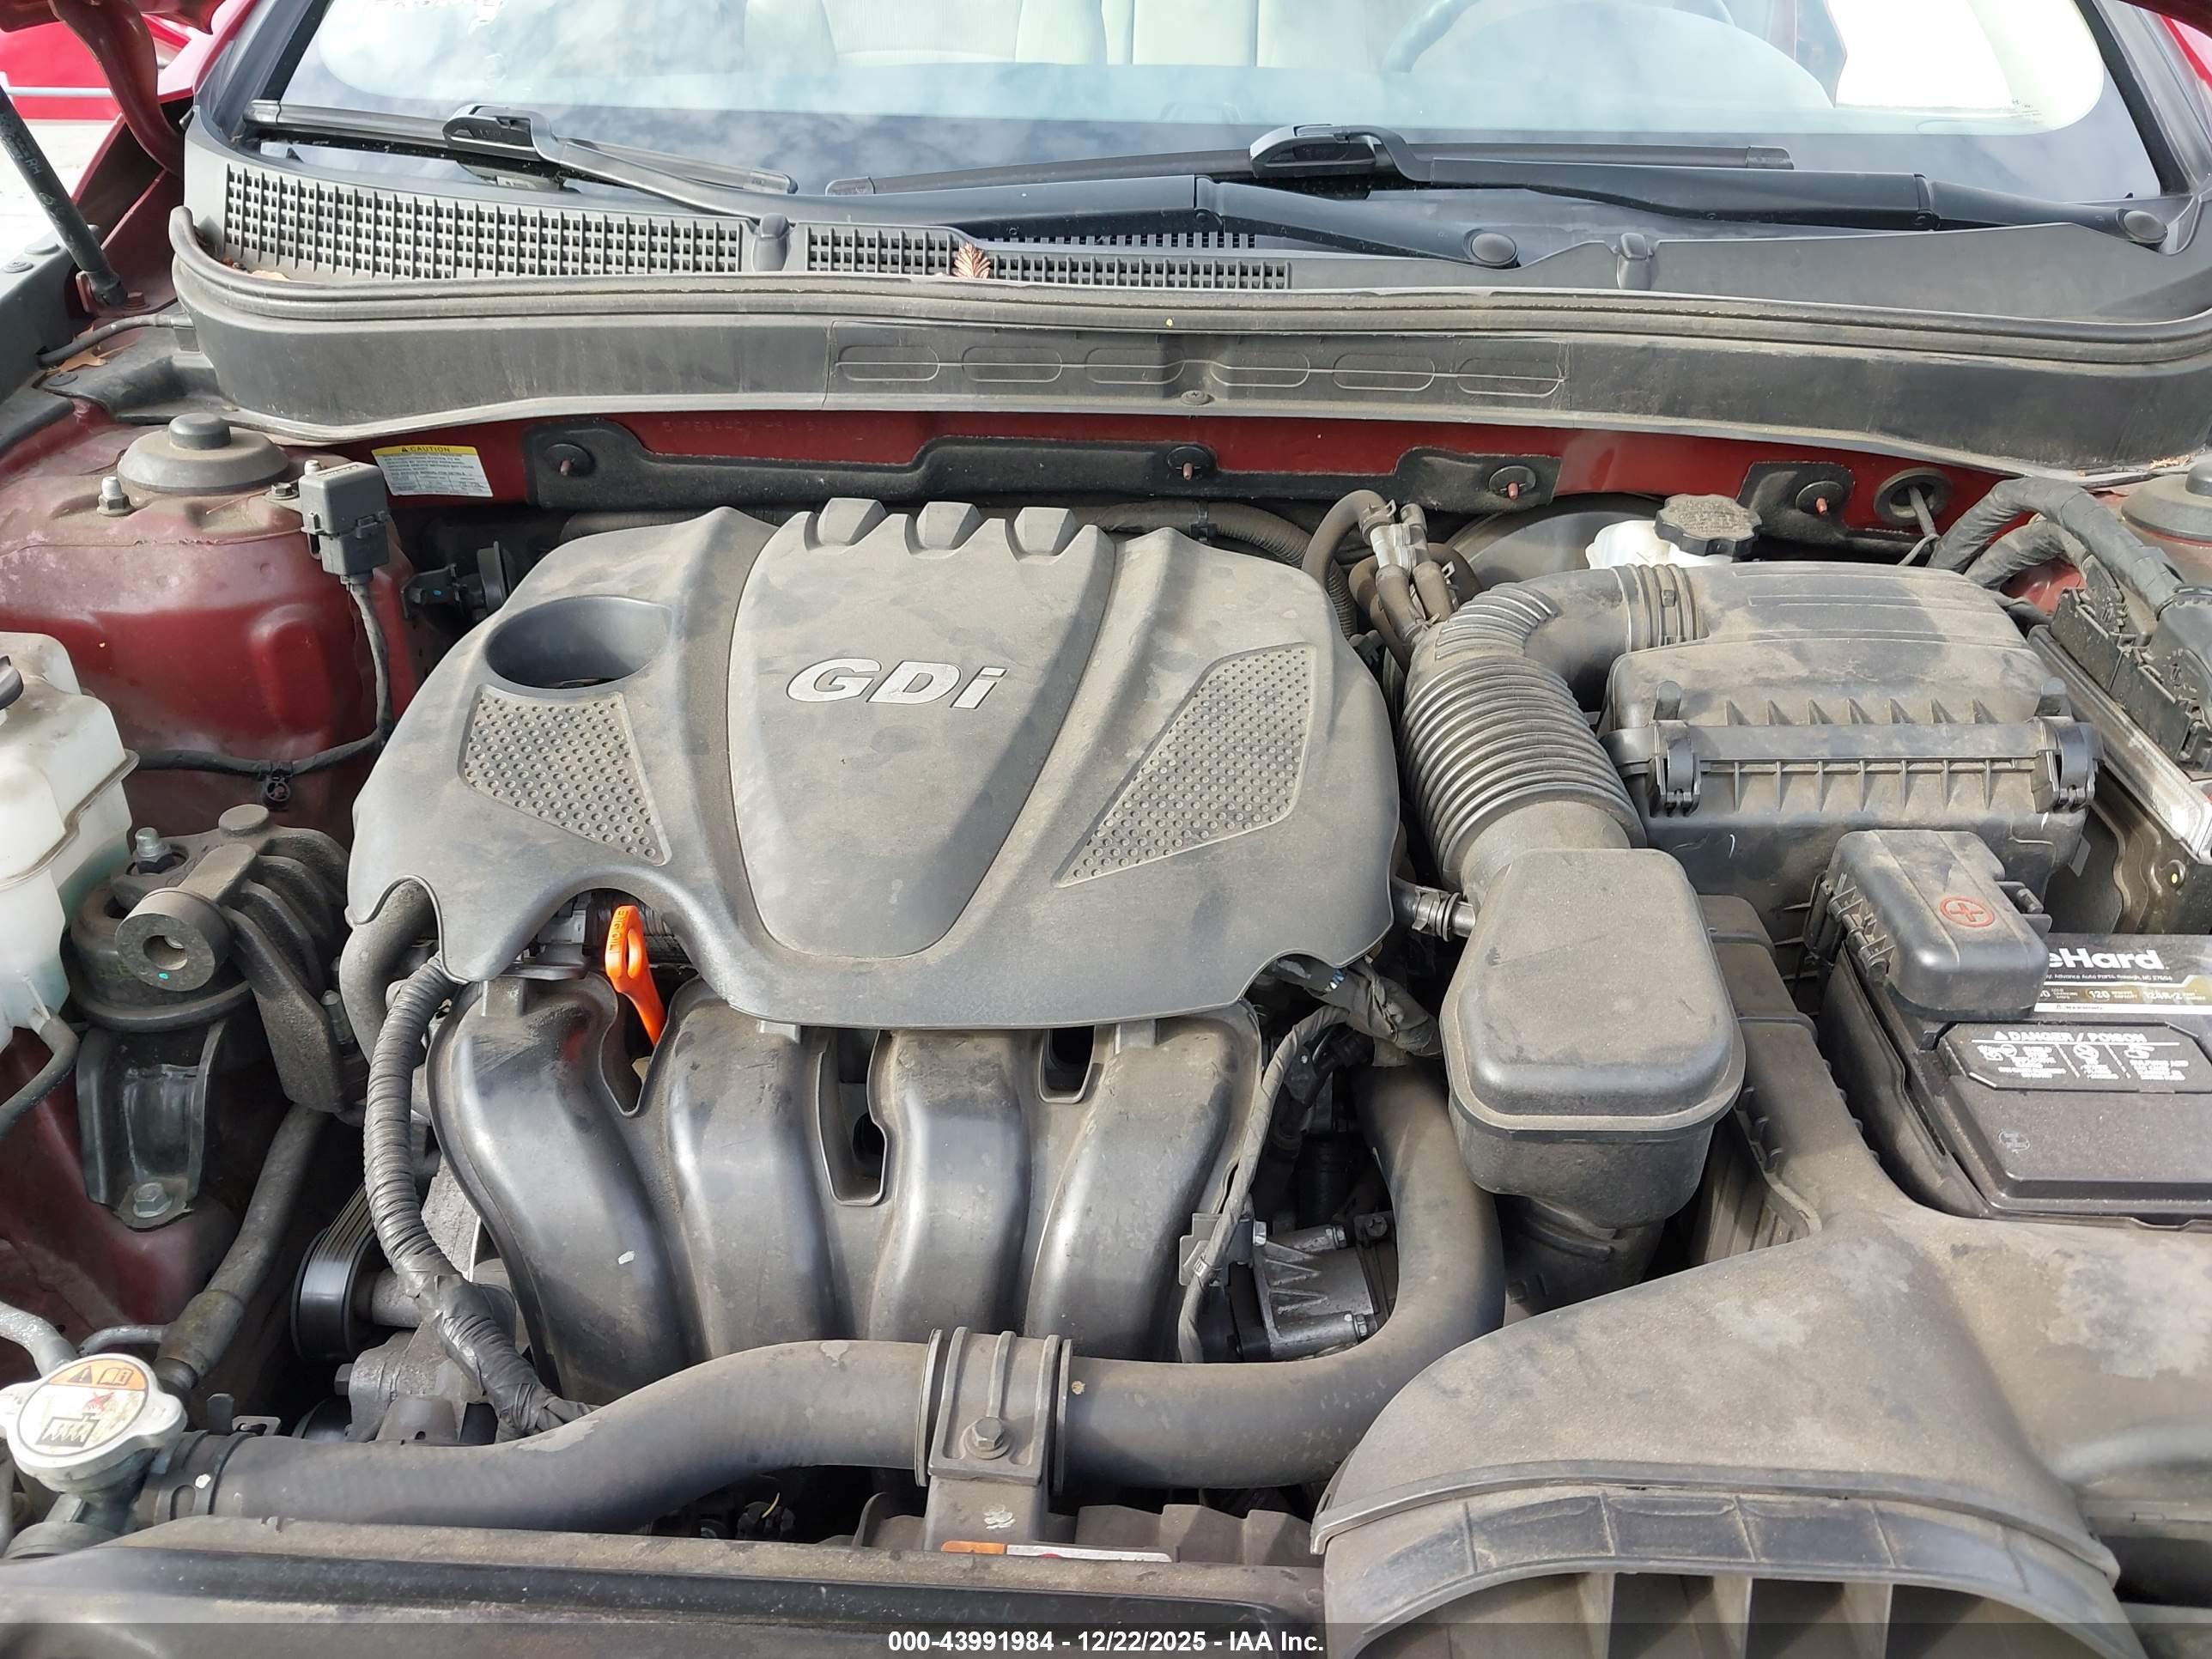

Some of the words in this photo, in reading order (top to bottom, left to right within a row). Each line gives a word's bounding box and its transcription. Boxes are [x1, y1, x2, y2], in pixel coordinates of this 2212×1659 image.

[786, 658, 1009, 710] GDi
[2088, 990, 2110, 999] 120
[2008, 1031, 2075, 1042] DANGER
[2087, 1033, 2148, 1042] POISON
